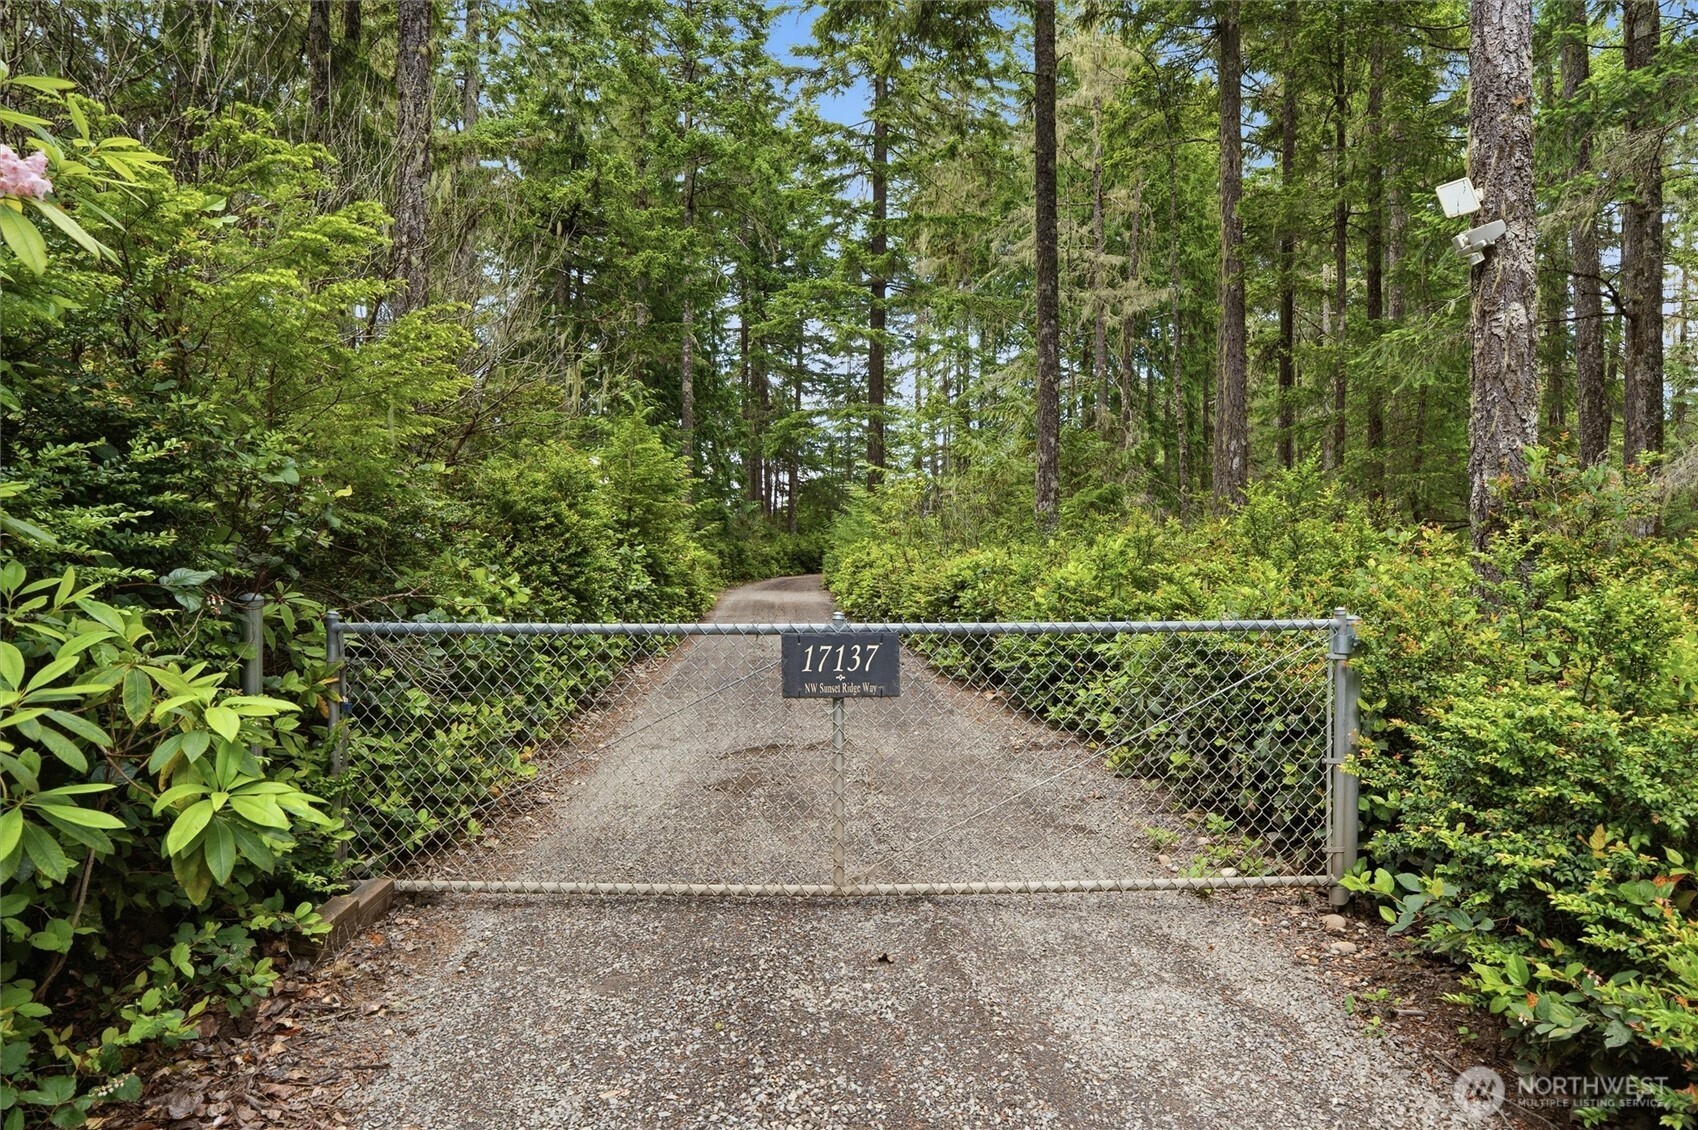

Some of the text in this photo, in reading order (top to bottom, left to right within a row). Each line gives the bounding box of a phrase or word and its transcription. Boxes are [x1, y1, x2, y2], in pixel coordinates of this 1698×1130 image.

[801, 644, 880, 673] 17137
[804, 682, 877, 696] NW Sunset Ridge Way
